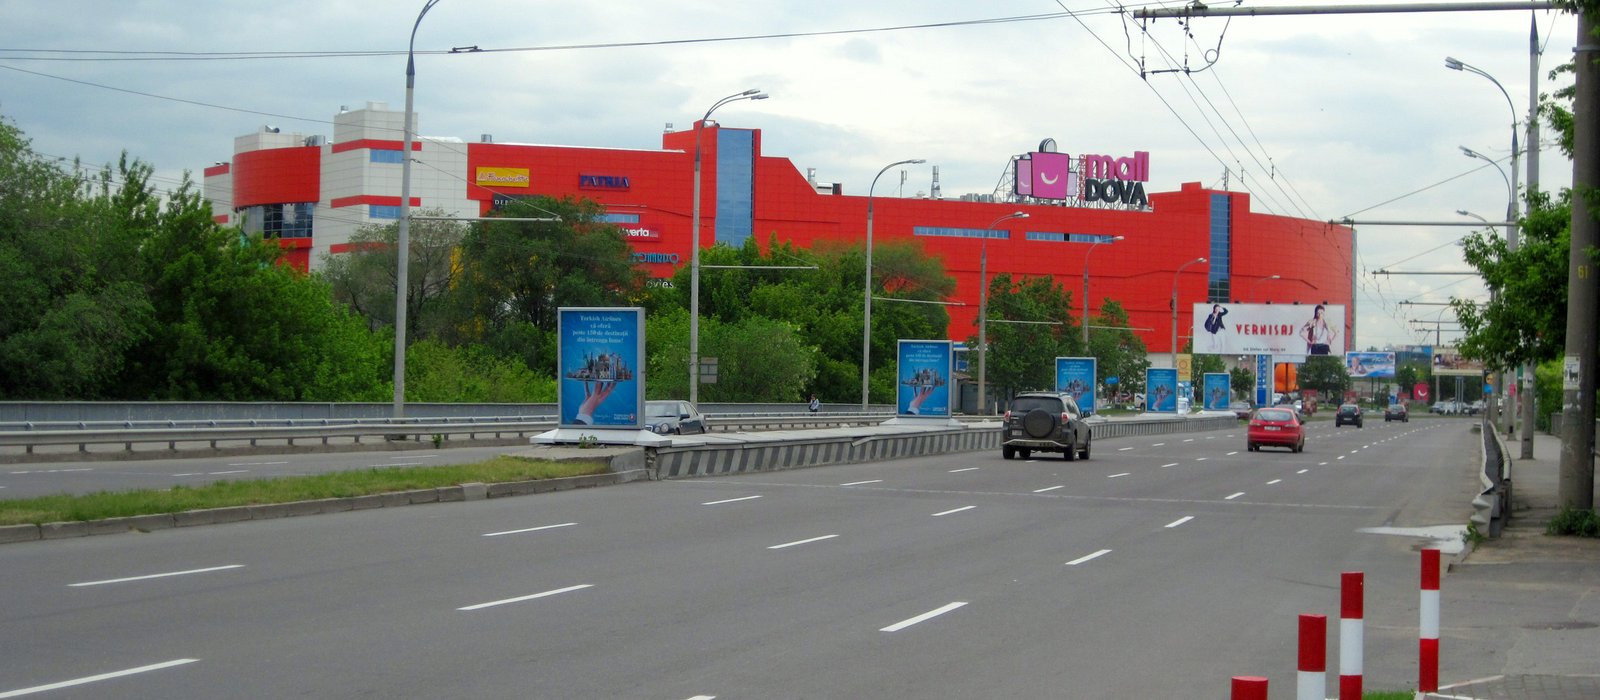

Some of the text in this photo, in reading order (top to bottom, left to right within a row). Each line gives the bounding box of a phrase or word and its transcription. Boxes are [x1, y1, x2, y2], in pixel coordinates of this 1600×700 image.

[1086, 151, 1149, 182] mall
[580, 175, 630, 188] PATRIA
[1085, 178, 1147, 205] DOVA
[1236, 324, 1293, 336] VERNISAJ
